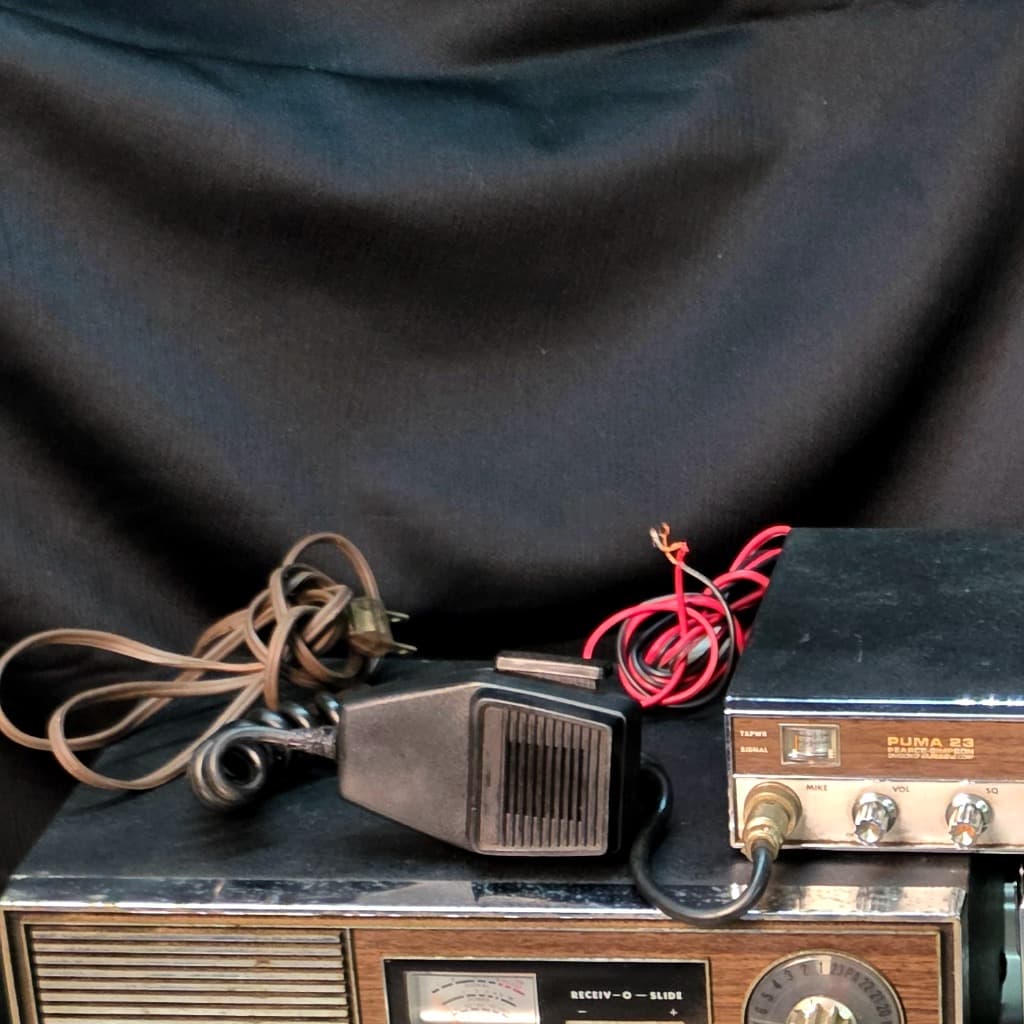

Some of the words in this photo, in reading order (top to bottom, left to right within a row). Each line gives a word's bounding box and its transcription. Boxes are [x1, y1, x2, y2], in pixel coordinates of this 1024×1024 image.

[886, 736, 943, 747] PUMA
[949, 737, 975, 748] 23
[805, 783, 828, 791] MIKE
[892, 785, 910, 793] VOL
[985, 787, 999, 795] SQ
